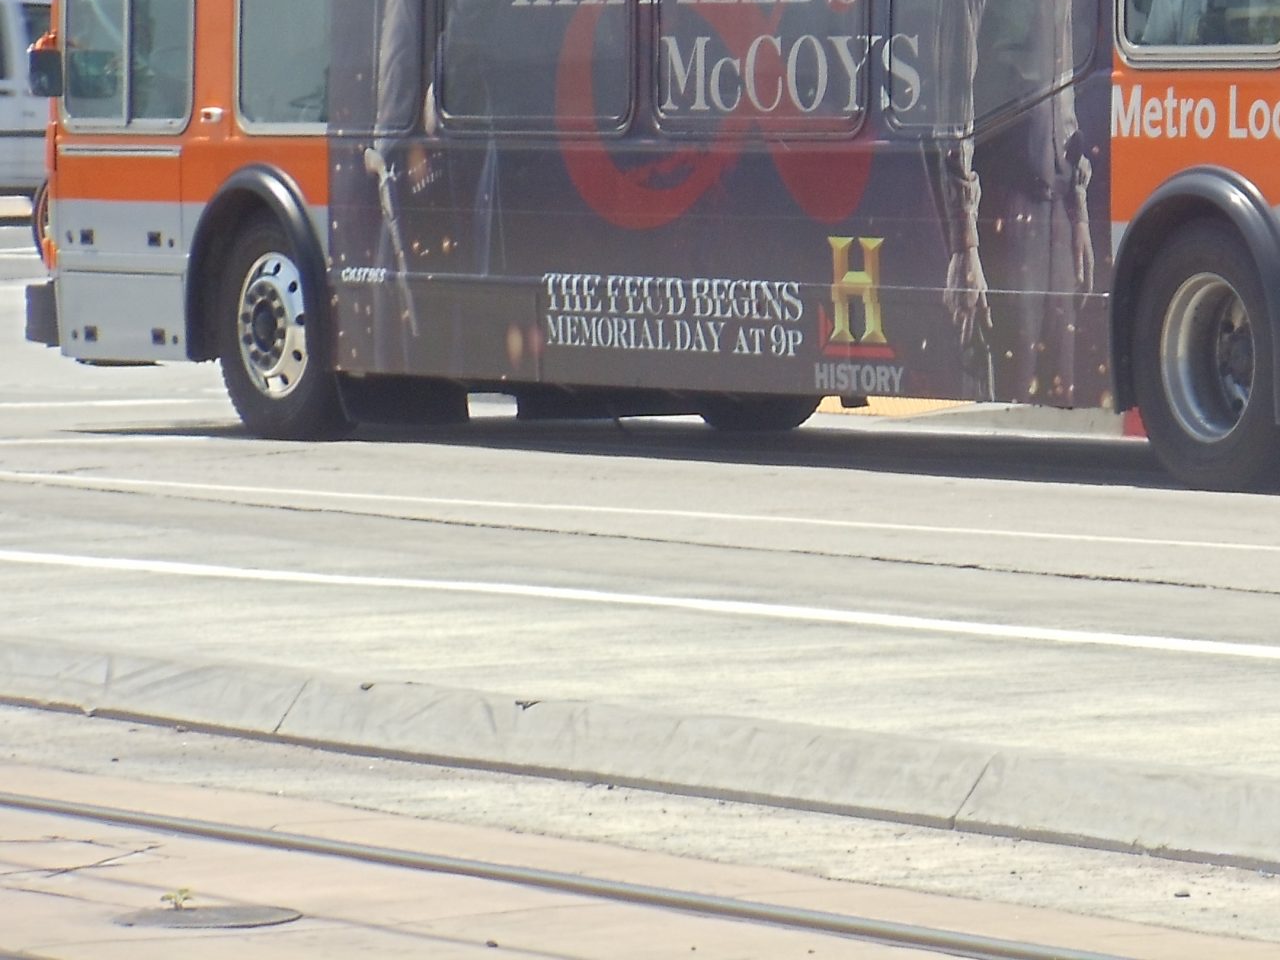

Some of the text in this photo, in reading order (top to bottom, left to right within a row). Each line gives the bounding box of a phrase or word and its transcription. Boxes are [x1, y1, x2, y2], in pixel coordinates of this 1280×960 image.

[660, 33, 922, 114] McCOYS
[1111, 85, 1215, 138] Metro
[542, 272, 803, 322] THE FEUD BEGINS
[546, 314, 803, 356] MEMORIAL DAY AT 9P
[814, 362, 904, 392] HISTORY
